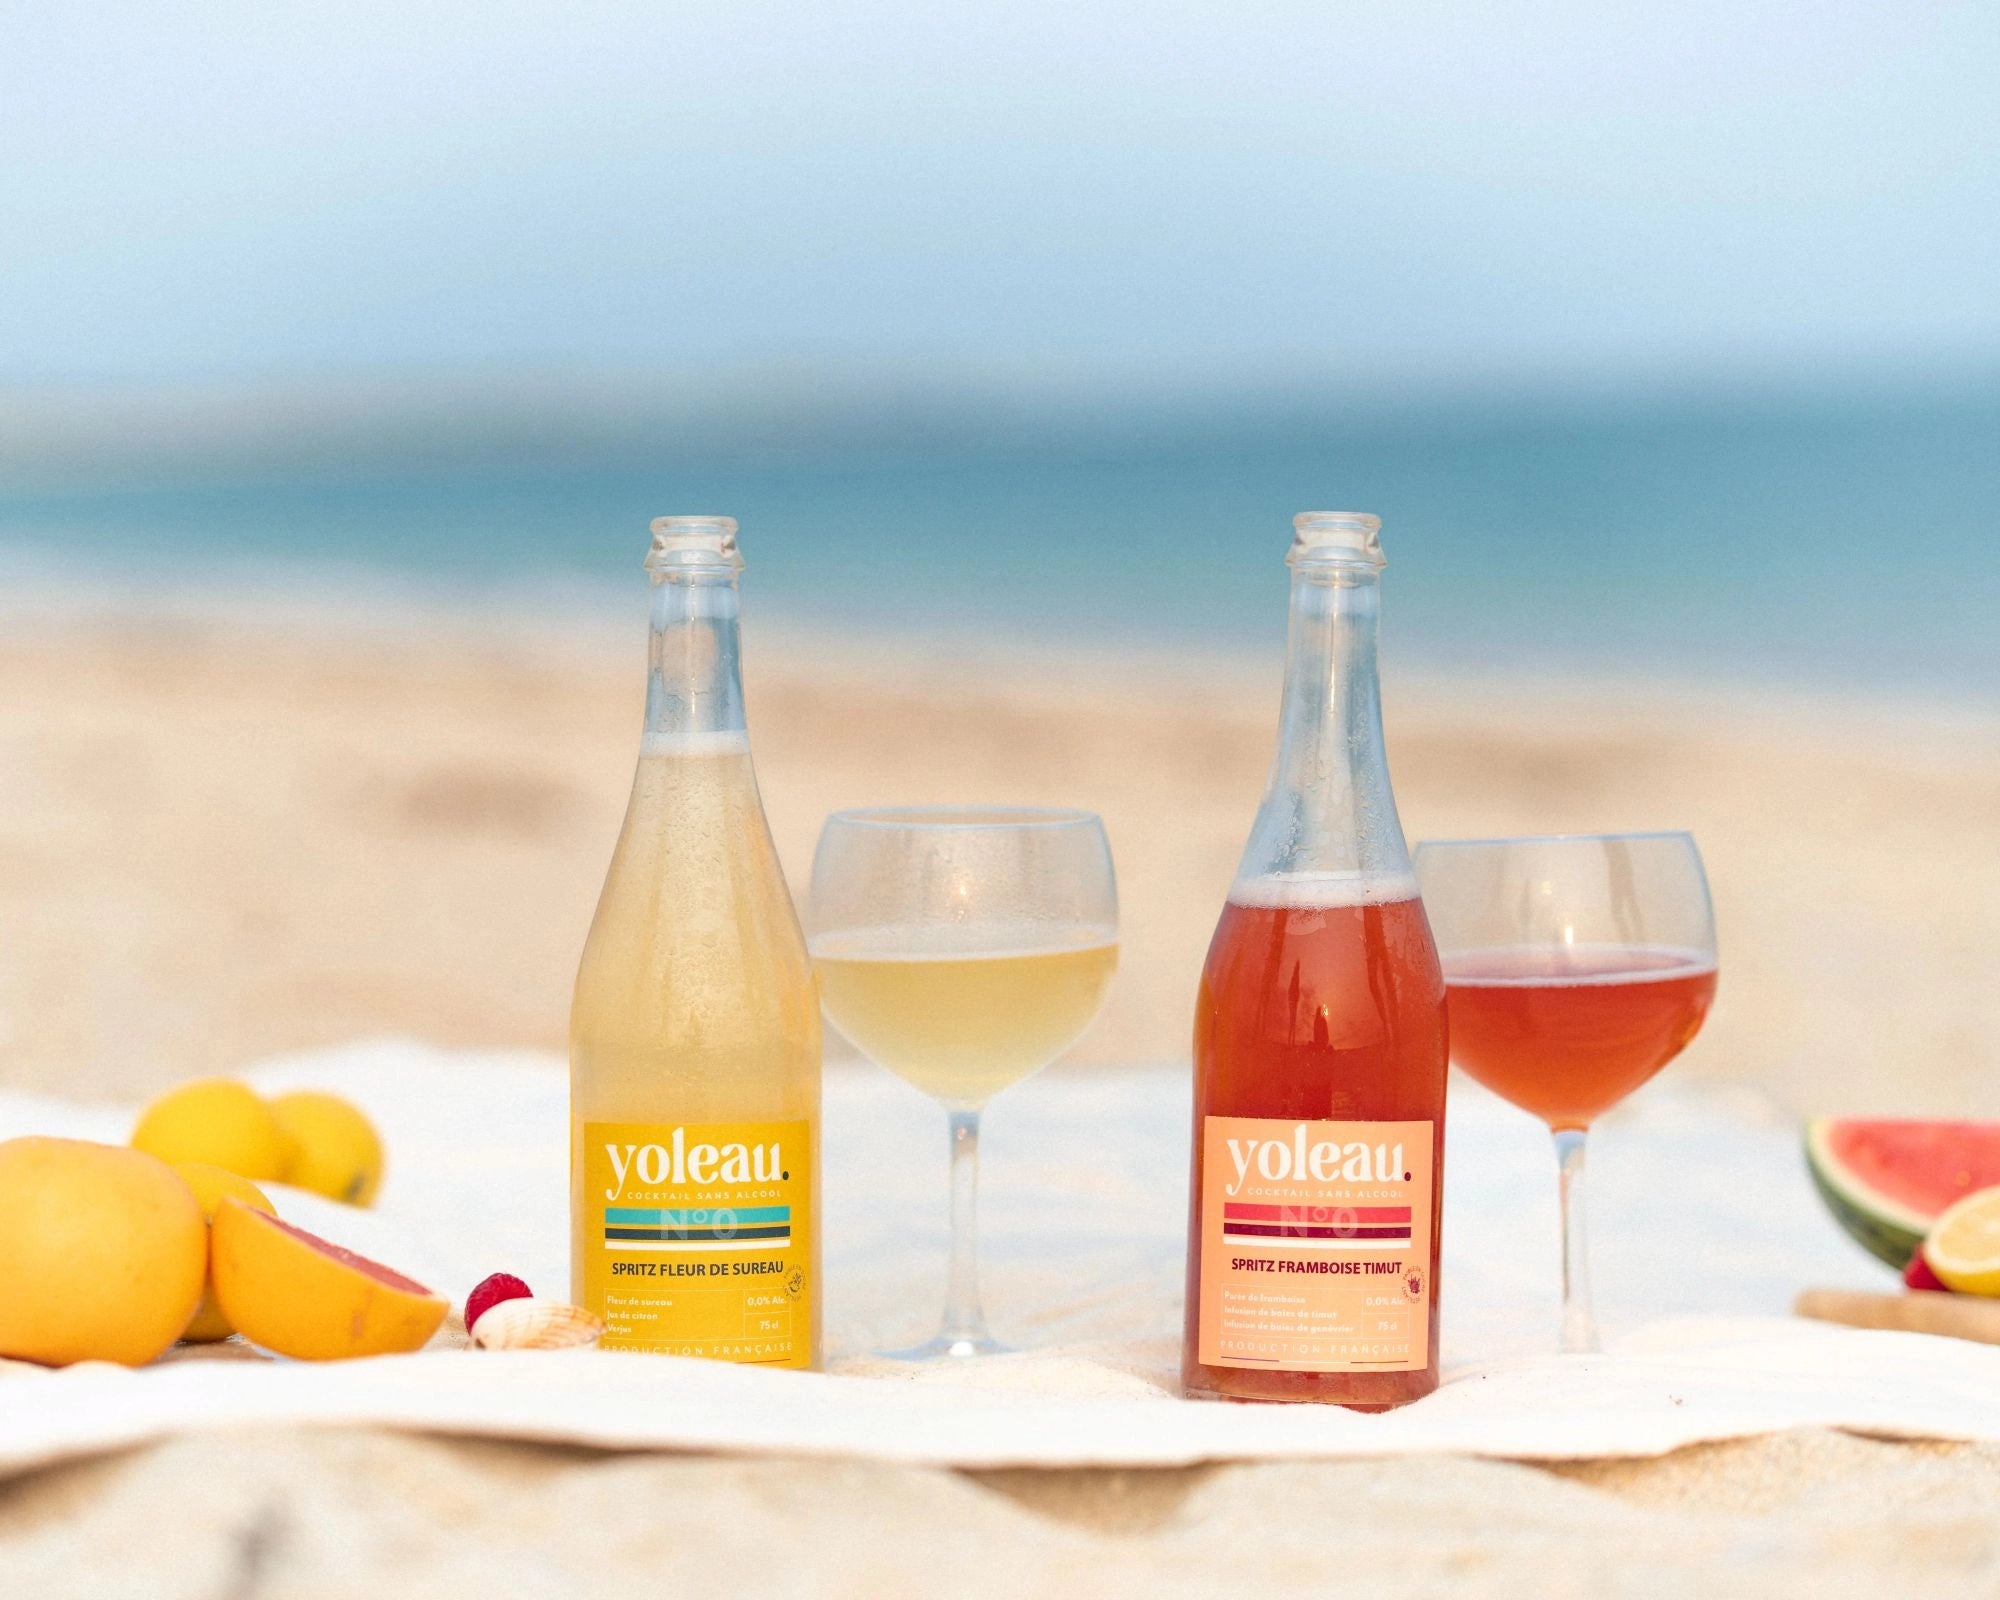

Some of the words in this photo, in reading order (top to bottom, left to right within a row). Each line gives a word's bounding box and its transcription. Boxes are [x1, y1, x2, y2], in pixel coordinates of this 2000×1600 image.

[605, 1127, 789, 1201] yoleau.
[1225, 1123, 1411, 1196] yoleau.
[627, 1191, 690, 1200] COCKTAIL
[697, 1191, 730, 1200] SANS
[736, 1190, 781, 1199] ALCOOL
[1247, 1187, 1311, 1197] COCKTAIL
[1318, 1189, 1351, 1198] SANS
[1357, 1189, 1404, 1198] ALCOOL
[612, 1262, 656, 1276] SPRITZ
[660, 1262, 705, 1277] FLEUR
[710, 1262, 729, 1276] DE
[732, 1260, 784, 1275] SUREAU
[1231, 1258, 1275, 1273] SPRITZ
[1278, 1260, 1360, 1275] FRAMBOISE
[1363, 1261, 1402, 1275] TIMUT
[607, 1295, 627, 1305] Fleur
[629, 1296, 639, 1306] de
[641, 1298, 673, 1306] sureau
[606, 1309, 618, 1320] Jus
[619, 1310, 630, 1320] de
[631, 1311, 658, 1320] citron
[607, 1323, 632, 1335] Verjus
[759, 1320, 771, 1330] 75
[1219, 1340, 1320, 1355] PRODUCTION
